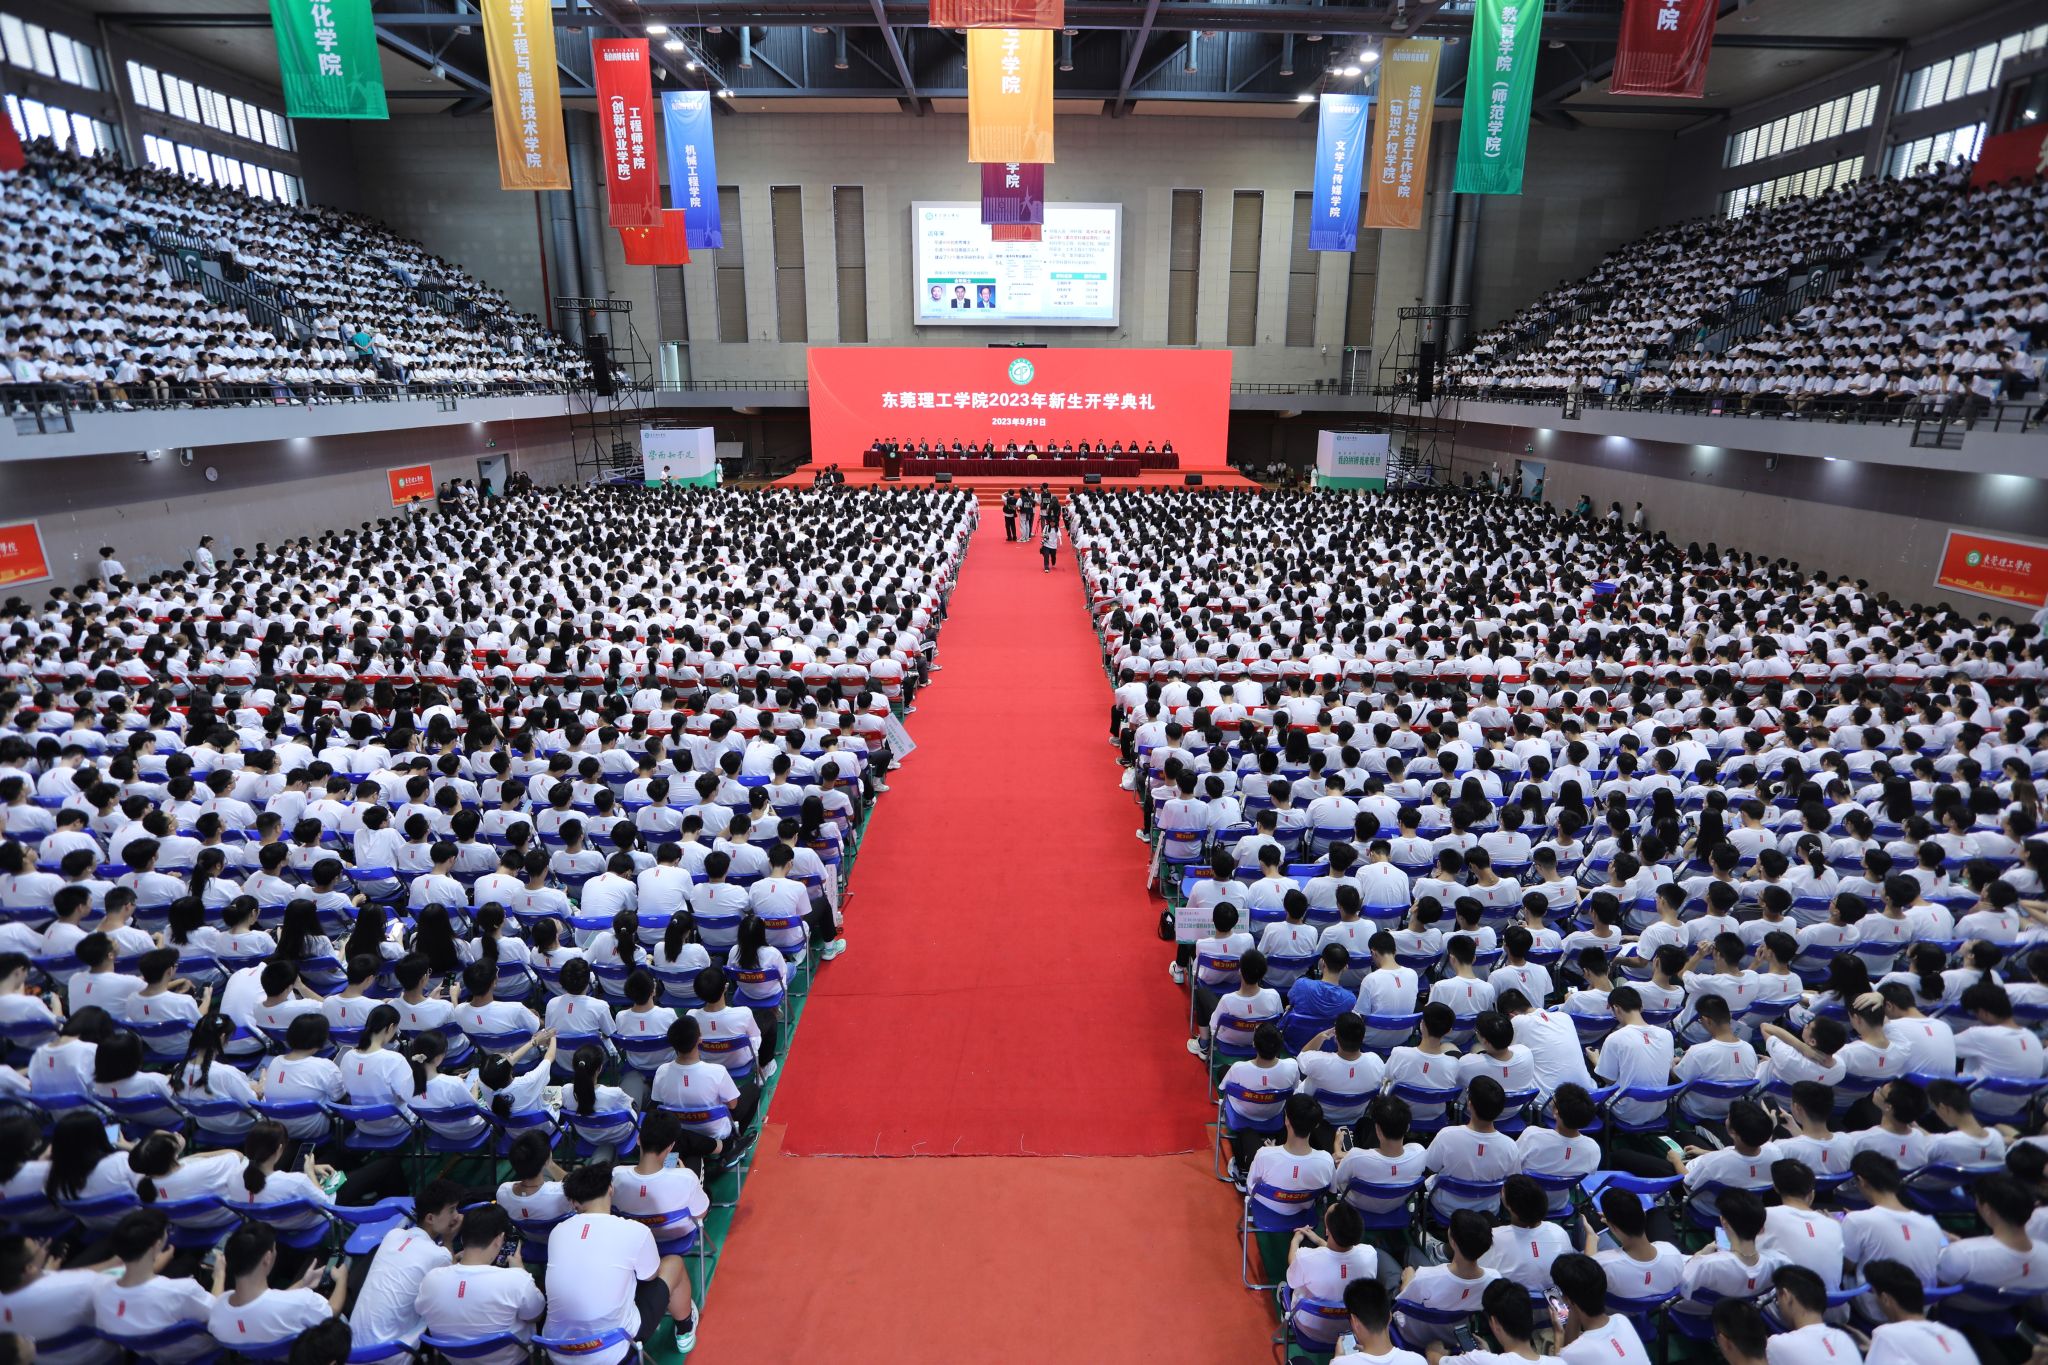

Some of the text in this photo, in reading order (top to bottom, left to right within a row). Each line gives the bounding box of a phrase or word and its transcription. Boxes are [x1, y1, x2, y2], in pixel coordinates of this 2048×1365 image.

[509, 0, 542, 168] 学工程与能源技术学院
[629, 107, 646, 170] 工程师学院
[1397, 85, 1422, 198] 法律与社会工作学院
[685, 144, 702, 208] 机械工程学院
[1329, 140, 1347, 218] 文学与传媒学院
[882, 392, 1155, 410] 东莞理工学院2023年新生开学典礼
[991, 417, 1046, 427] 2023年9月9日
